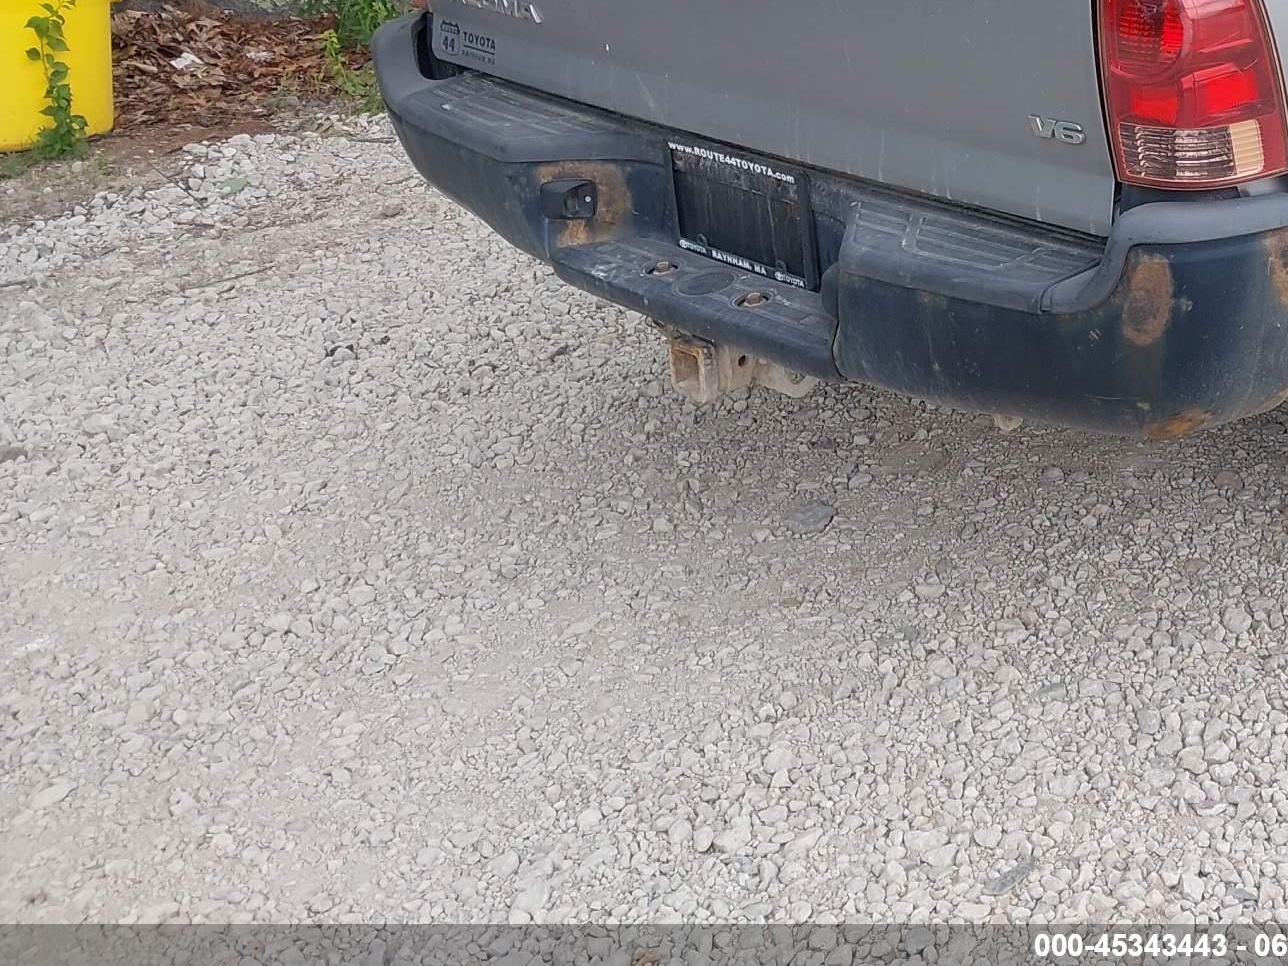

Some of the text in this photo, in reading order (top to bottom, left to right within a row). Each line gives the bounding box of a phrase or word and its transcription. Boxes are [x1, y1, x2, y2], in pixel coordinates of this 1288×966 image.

[442, 36, 455, 52] 44
[463, 31, 496, 50] TOYOTA
[1027, 114, 1086, 145] V6
[667, 140, 795, 184] www.ROUTE44TOYOTA.com
[754, 264, 767, 276] MA
